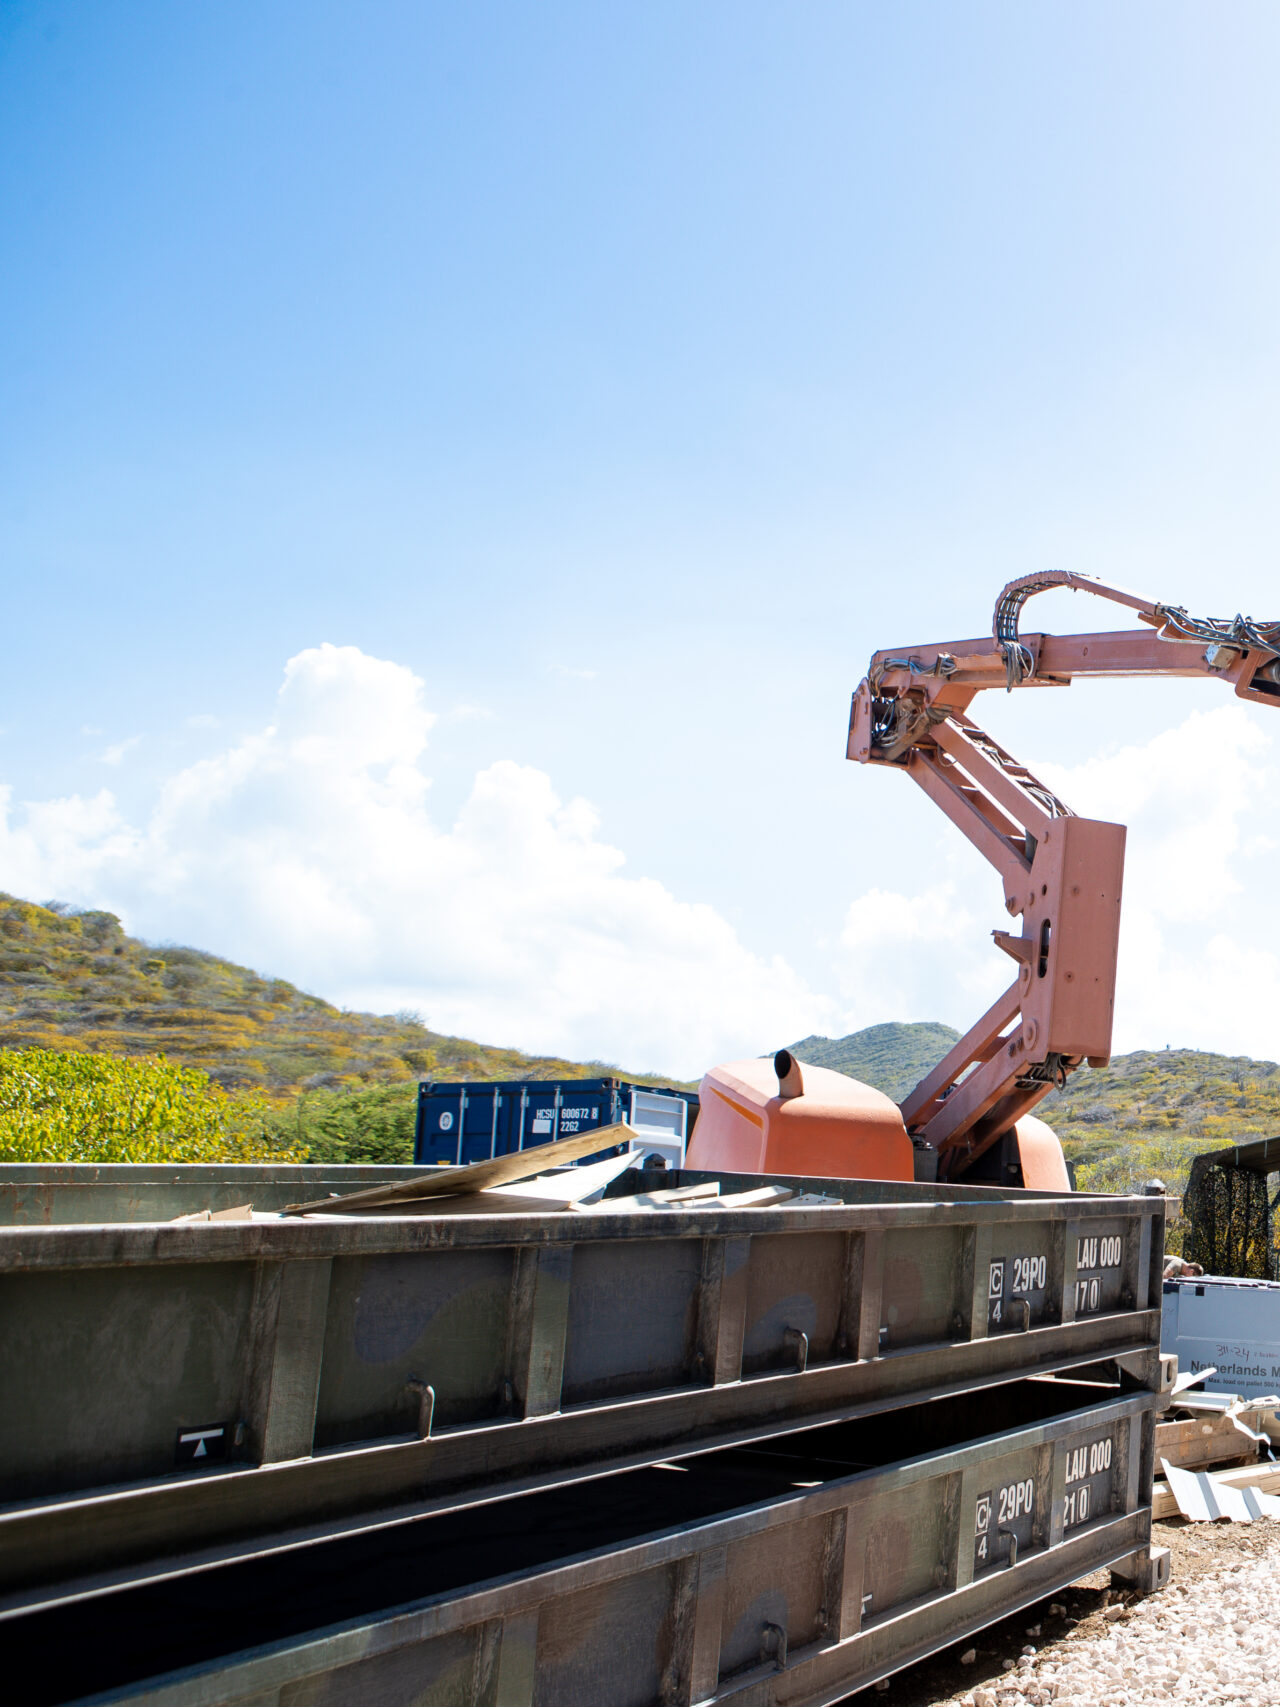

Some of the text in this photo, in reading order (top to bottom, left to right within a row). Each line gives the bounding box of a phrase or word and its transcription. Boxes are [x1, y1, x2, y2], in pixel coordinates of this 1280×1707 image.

[536, 1107, 598, 1119] HCSU 600672 8
[1100, 1236, 1121, 1267] 000
[992, 1300, 1002, 1323] 4
[1065, 1438, 1112, 1484] LAU 000
[977, 1536, 988, 1559] 4
